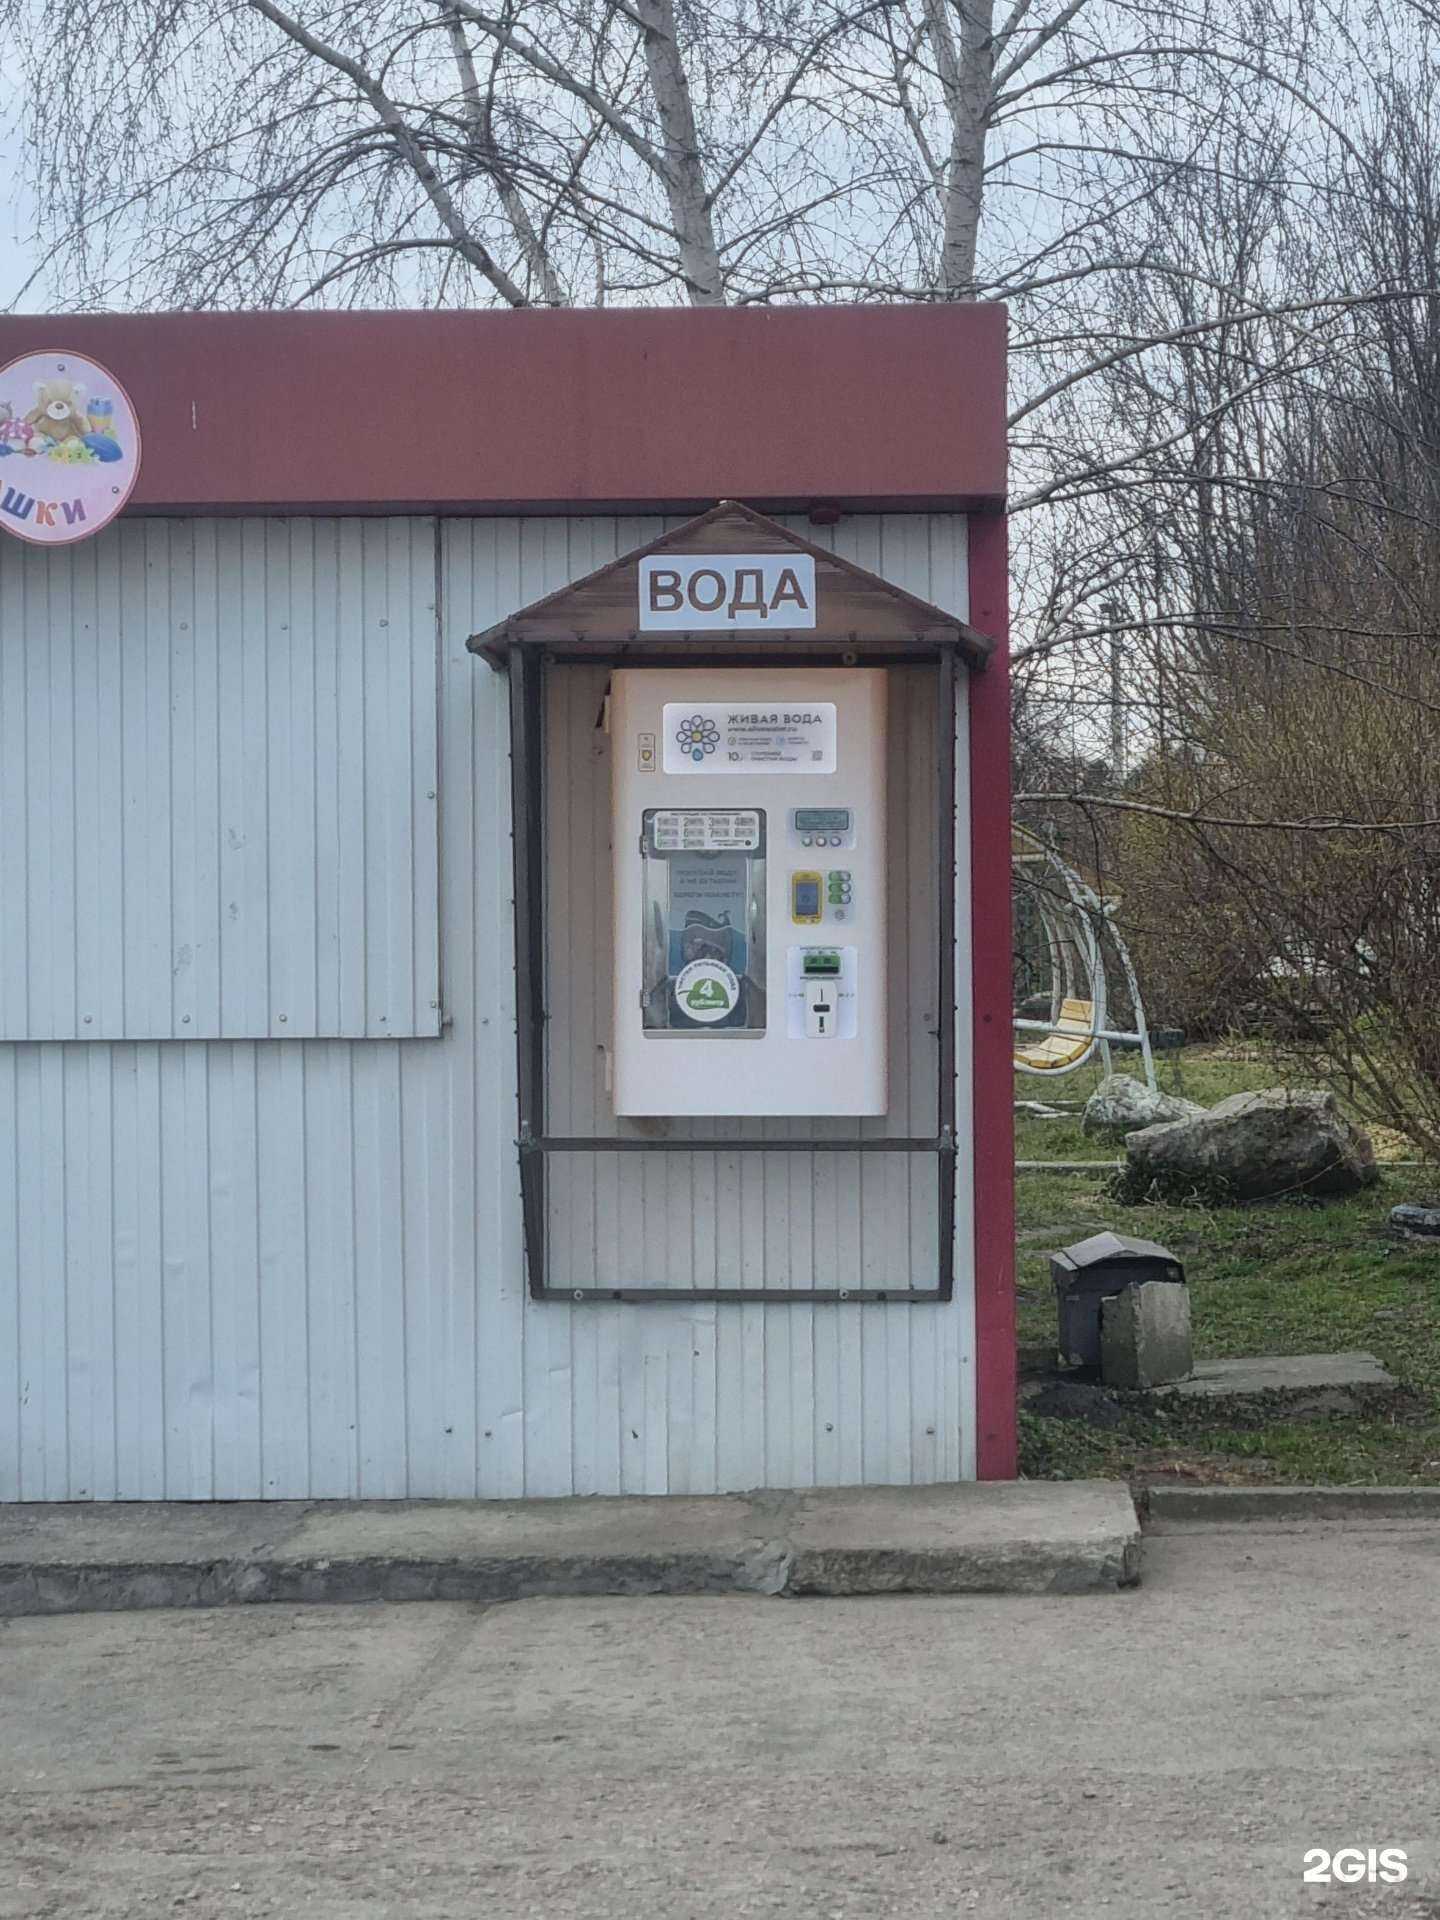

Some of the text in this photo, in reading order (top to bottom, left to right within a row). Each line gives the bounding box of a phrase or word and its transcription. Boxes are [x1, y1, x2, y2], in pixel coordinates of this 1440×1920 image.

[649, 568, 809, 619] ВОДА
[727, 713, 823, 725] ЖИВАЯ ВОДА
[699, 980, 714, 998] 4
